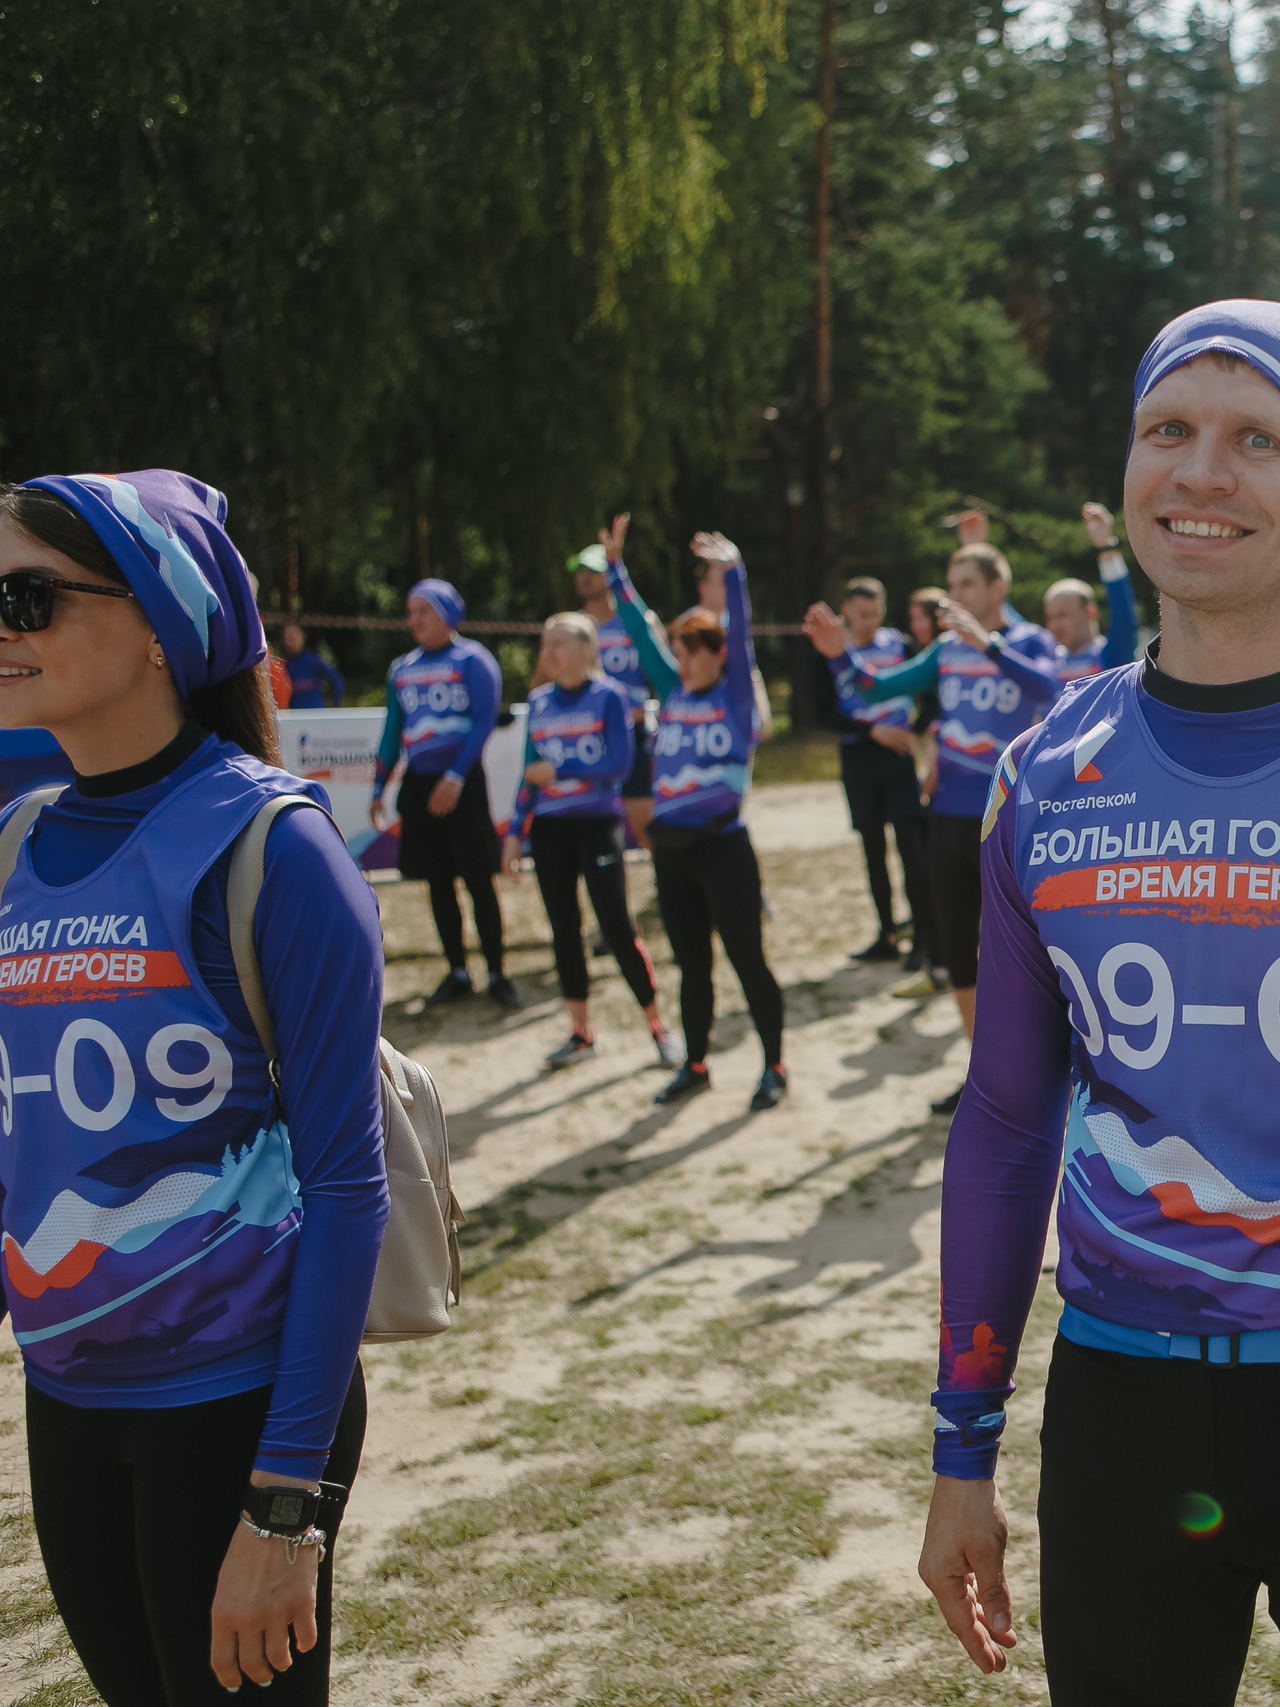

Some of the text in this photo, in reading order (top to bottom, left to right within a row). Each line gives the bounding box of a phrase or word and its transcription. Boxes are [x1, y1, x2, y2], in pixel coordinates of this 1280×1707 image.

[1038, 791, 1137, 815] Ростелеком
[1029, 818, 1215, 865] БОЛЬШАЯ
[1096, 865, 1216, 901] ВРЕМЯ
[51, 914, 149, 948] ГОНКА
[0, 952, 147, 989] ЕМЯ ГЕРОЕВ
